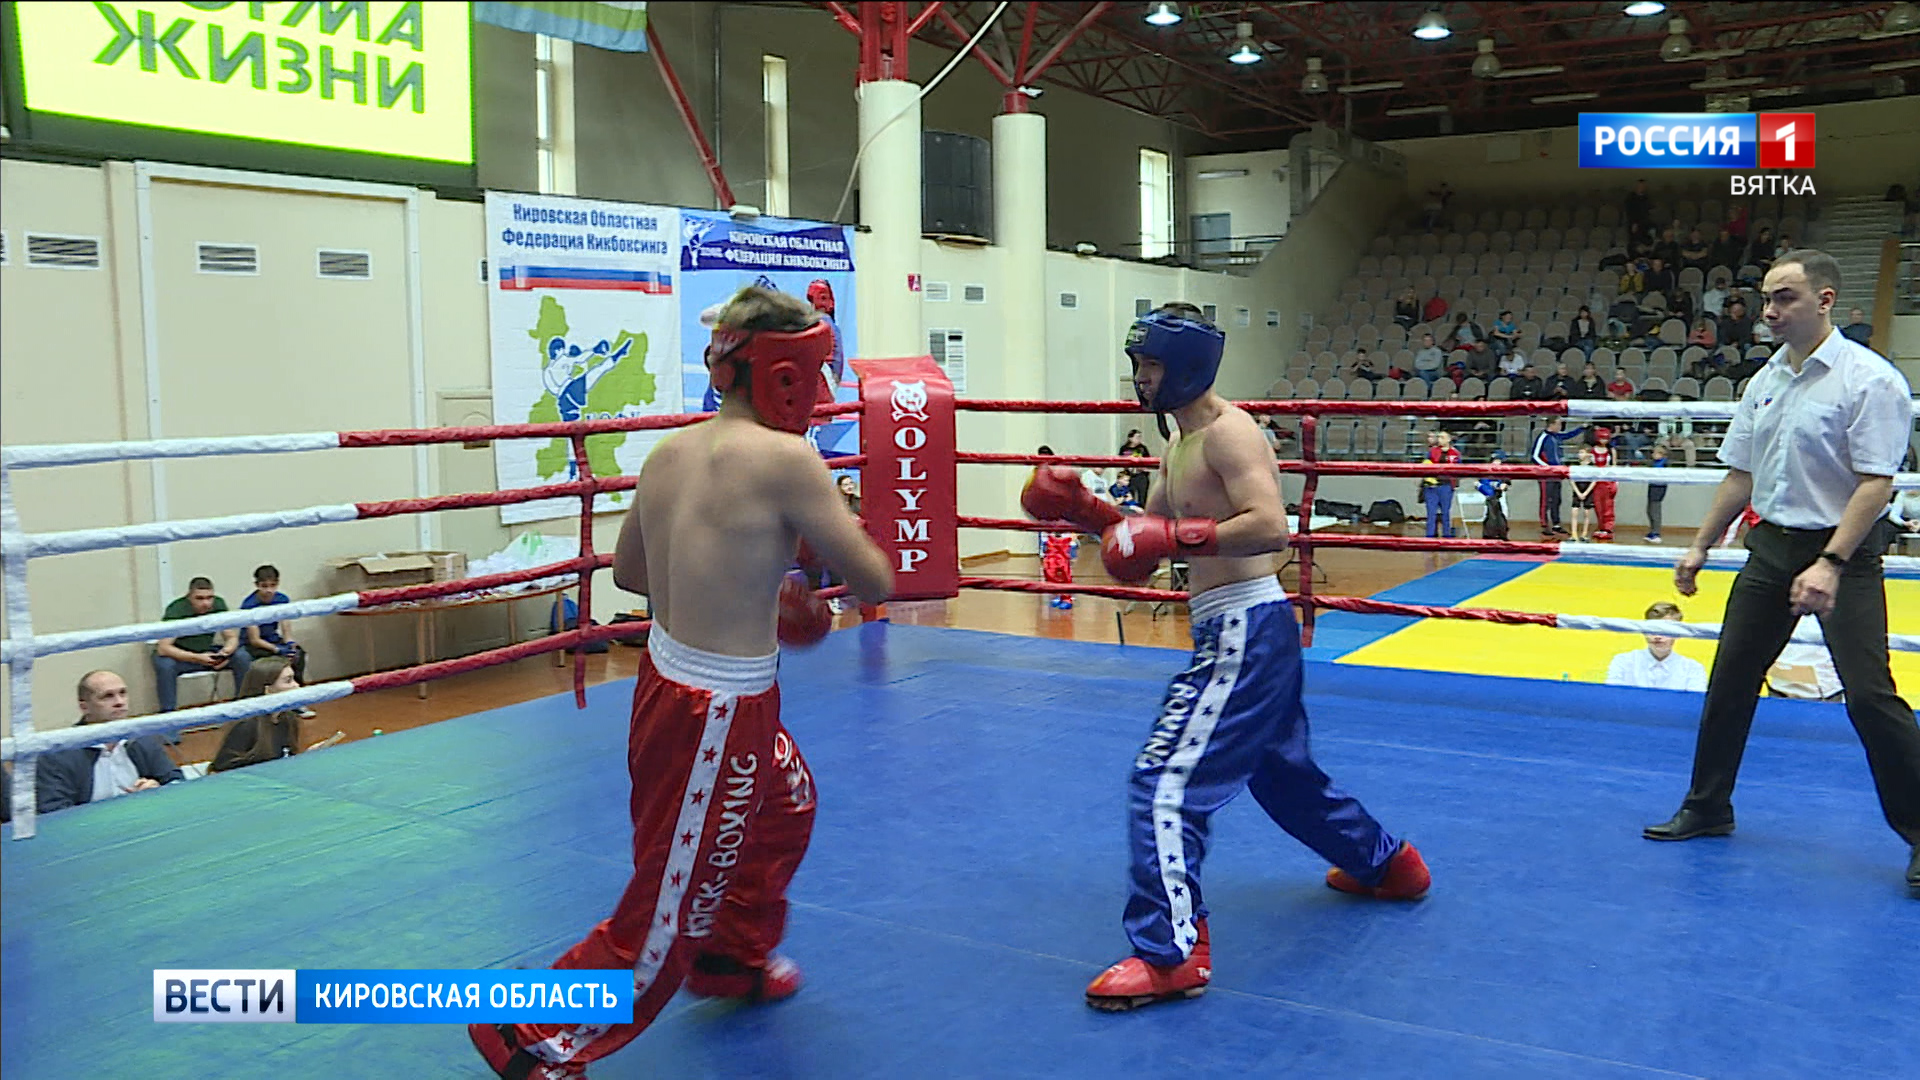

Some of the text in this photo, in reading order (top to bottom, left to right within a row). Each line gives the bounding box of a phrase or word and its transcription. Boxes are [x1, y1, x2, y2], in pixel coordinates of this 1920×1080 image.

[93, 1, 424, 114] ЖИЗНИ
[502, 228, 668, 254] Федерация Кикбоксинга
[513, 203, 658, 231] Кировская Областная
[893, 427, 932, 573] OLYMP
